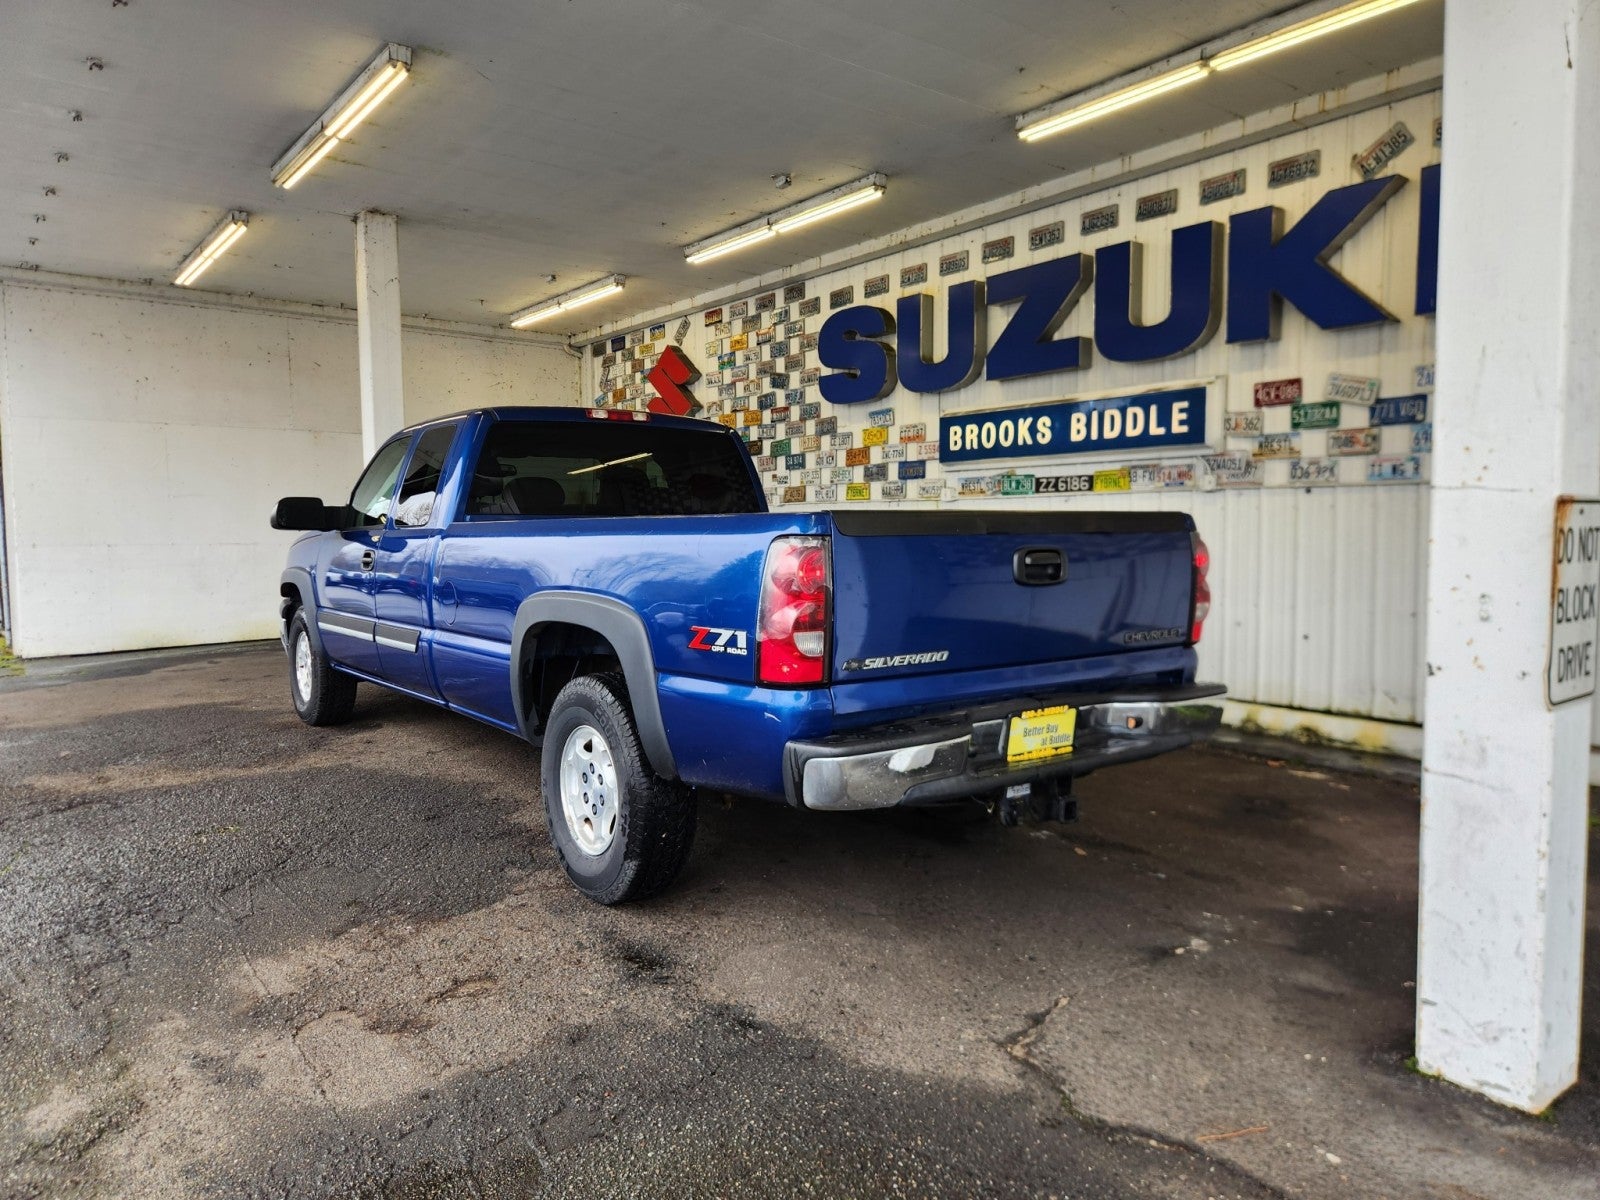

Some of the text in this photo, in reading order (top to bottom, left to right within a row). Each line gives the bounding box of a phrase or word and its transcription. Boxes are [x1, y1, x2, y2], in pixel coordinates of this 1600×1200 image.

[949, 399, 1192, 452] BROOKS BIDDLE
[1039, 476, 1090, 492] ZZ 6186
[1557, 528, 1573, 564] DO
[1556, 584, 1596, 624] BLOCK
[688, 625, 747, 650] Z71
[711, 645, 747, 655] OFF ROAD
[863, 650, 950, 670] SILVERADO
[1557, 641, 1592, 684] DRIVE
[1023, 723, 1058, 738] Better Buy
[1049, 734, 1071, 745] Biddle
